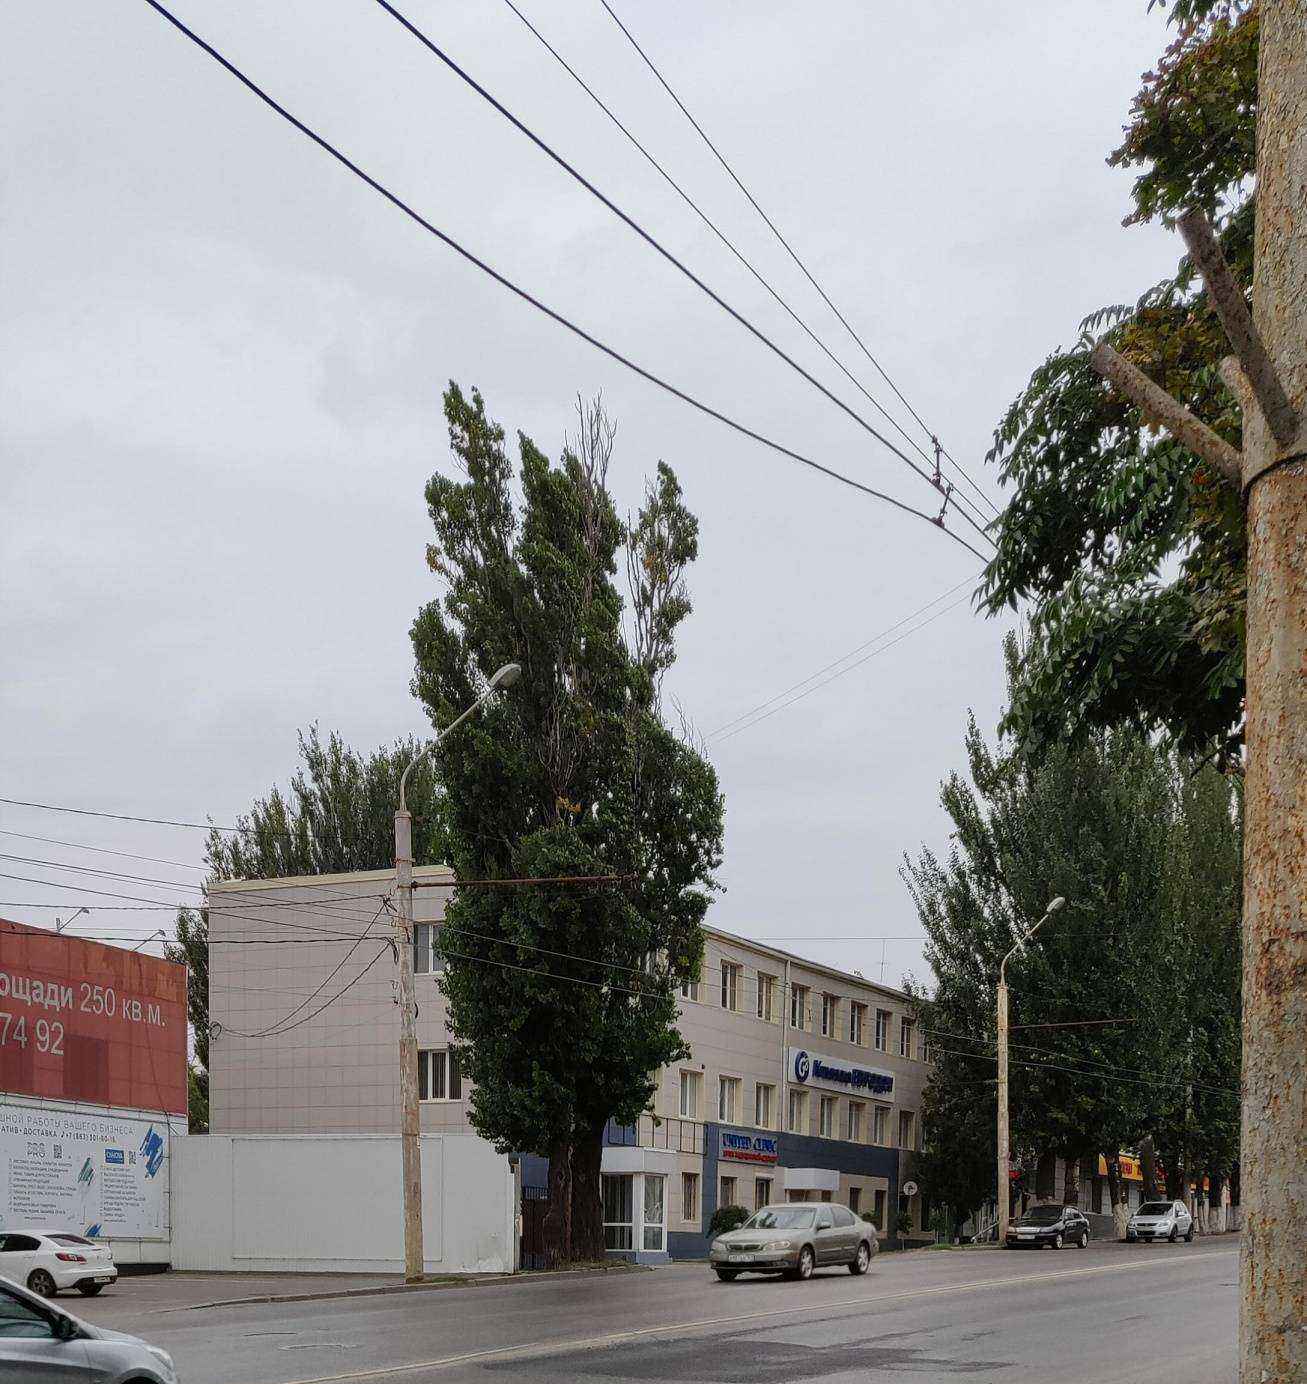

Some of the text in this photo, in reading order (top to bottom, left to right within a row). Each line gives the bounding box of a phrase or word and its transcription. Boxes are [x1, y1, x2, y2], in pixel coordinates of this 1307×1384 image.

[0, 972, 73, 1011] ощади
[80, 982, 116, 1016] 250
[0, 1013, 65, 1056] 74 92
[27, 1115, 60, 1127] РАБОТЫ
[63, 1119, 97, 1132] ВАШЕГО
